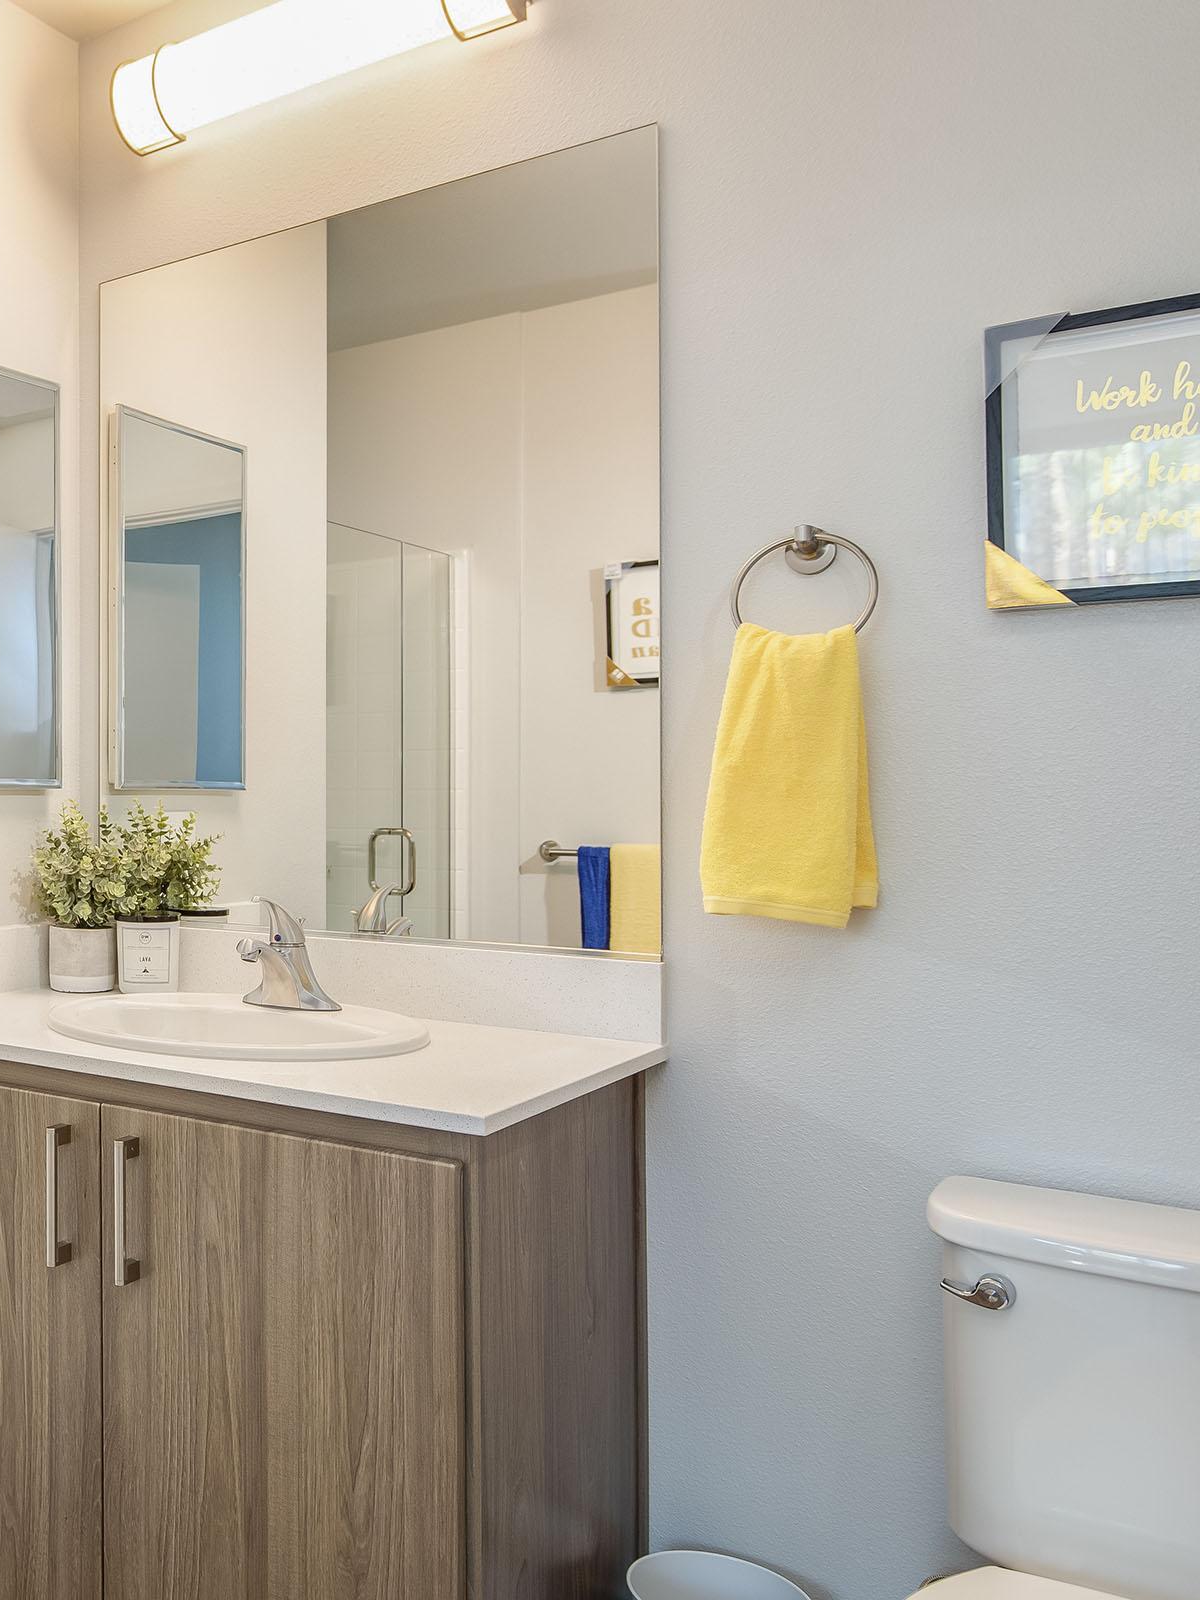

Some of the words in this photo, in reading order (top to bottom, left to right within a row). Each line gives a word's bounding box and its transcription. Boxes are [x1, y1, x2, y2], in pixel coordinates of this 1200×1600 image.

[1076, 370, 1162, 413] Work
[1130, 402, 1199, 442] and
[1088, 503, 1129, 540] to
